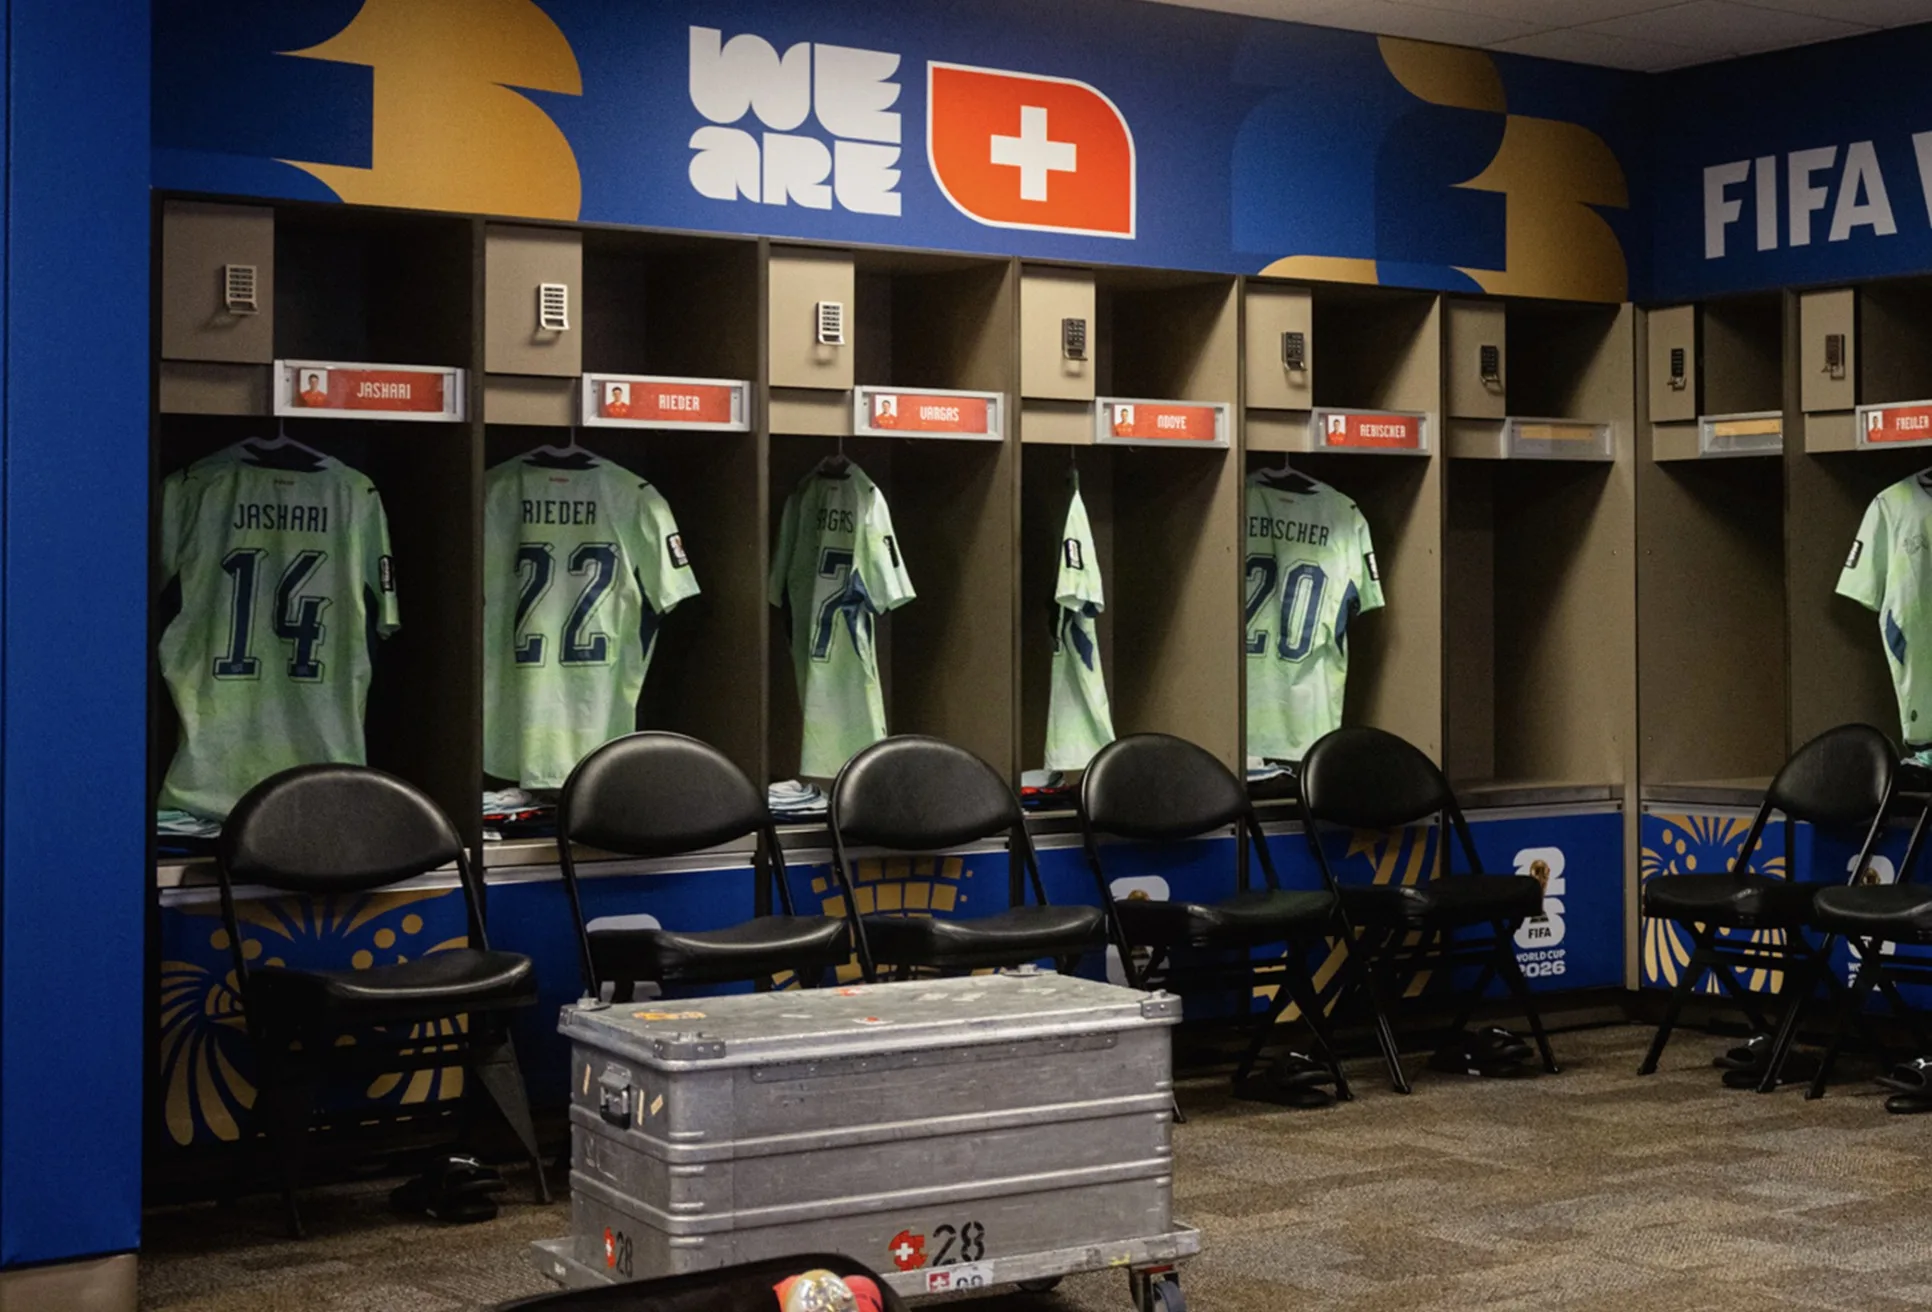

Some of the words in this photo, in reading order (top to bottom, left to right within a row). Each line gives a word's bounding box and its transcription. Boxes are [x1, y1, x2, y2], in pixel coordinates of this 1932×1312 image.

[689, 25, 902, 144] WE
[1703, 140, 1898, 260] FIFA
[356, 381, 412, 400] JASHARI
[658, 393, 700, 411] RIEDER
[920, 405, 960, 422] VARGAS
[1359, 422, 1406, 439] AEBISCHER
[233, 503, 328, 533] JASHARI
[522, 500, 597, 525] RIEDER
[1247, 515, 1330, 547] EBISCHER
[212, 547, 334, 684] 14
[514, 541, 621, 668] 22
[1246, 553, 1328, 664] 20
[1528, 927, 1552, 939] FIFA
[1547, 949, 1566, 960] CUP
[616, 1231, 634, 1279] 28
[932, 1220, 985, 1267] 28
